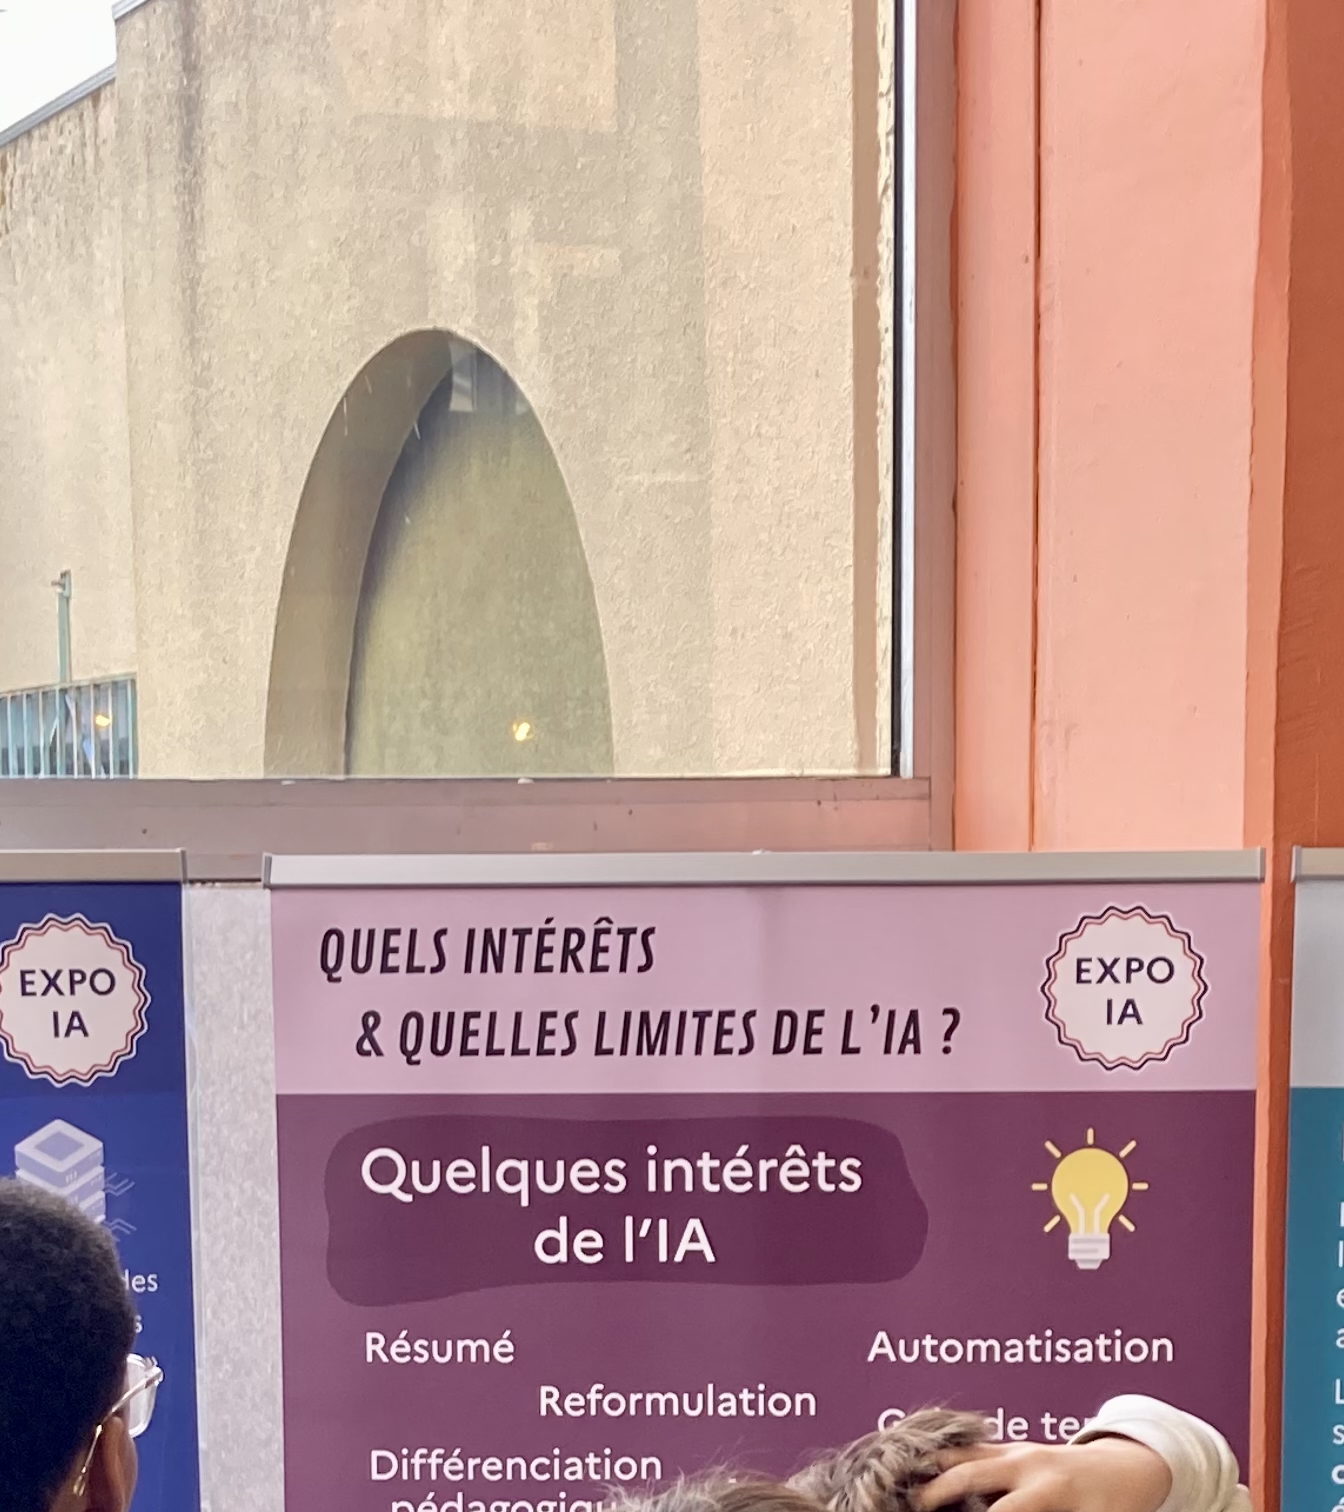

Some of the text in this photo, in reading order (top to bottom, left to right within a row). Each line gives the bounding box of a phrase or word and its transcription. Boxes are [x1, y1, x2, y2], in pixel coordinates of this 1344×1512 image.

[320, 917, 655, 983] QUELS INTÉRÊTS
[20, 968, 115, 996] EXPO
[1076, 957, 1174, 984] EXPO
[53, 1011, 89, 1038] IA
[1107, 999, 1143, 1025] IA
[356, 1004, 960, 1065] & QUELLES LIMITES DE L'IA ?
[362, 1145, 861, 1206] Quelques intérêts
[535, 1216, 715, 1263] de l'IA
[366, 1330, 514, 1363] Résumé
[867, 1329, 1172, 1363] Automatisation
[541, 1384, 815, 1416] Reformulation
[371, 1448, 661, 1481] Différenciation
